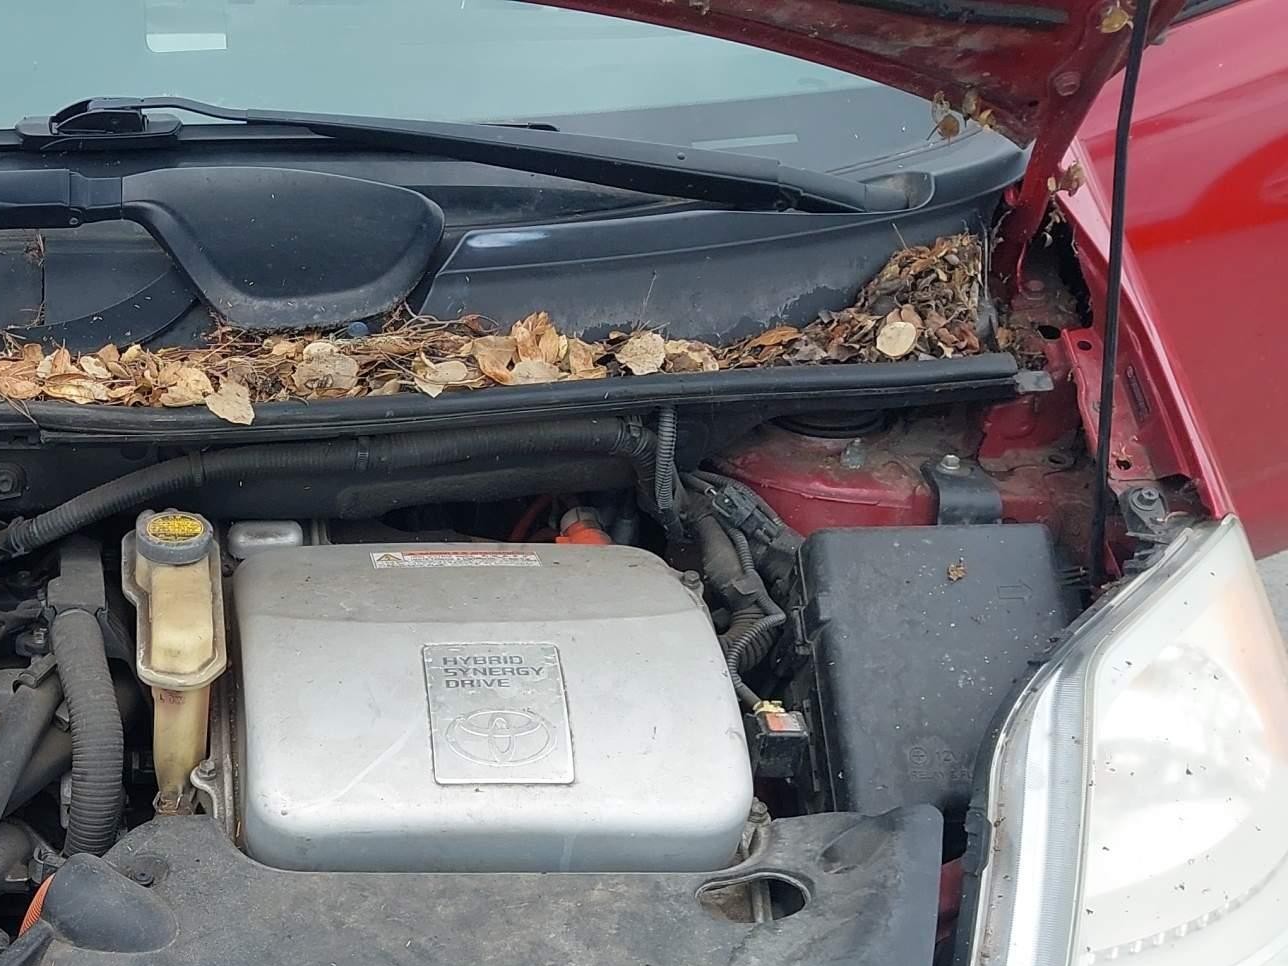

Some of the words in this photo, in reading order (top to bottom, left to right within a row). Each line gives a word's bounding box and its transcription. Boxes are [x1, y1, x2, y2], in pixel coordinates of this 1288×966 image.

[442, 655, 523, 666] HYBRID
[443, 666, 544, 677] SYNERGY
[445, 678, 511, 689] DRIVE
